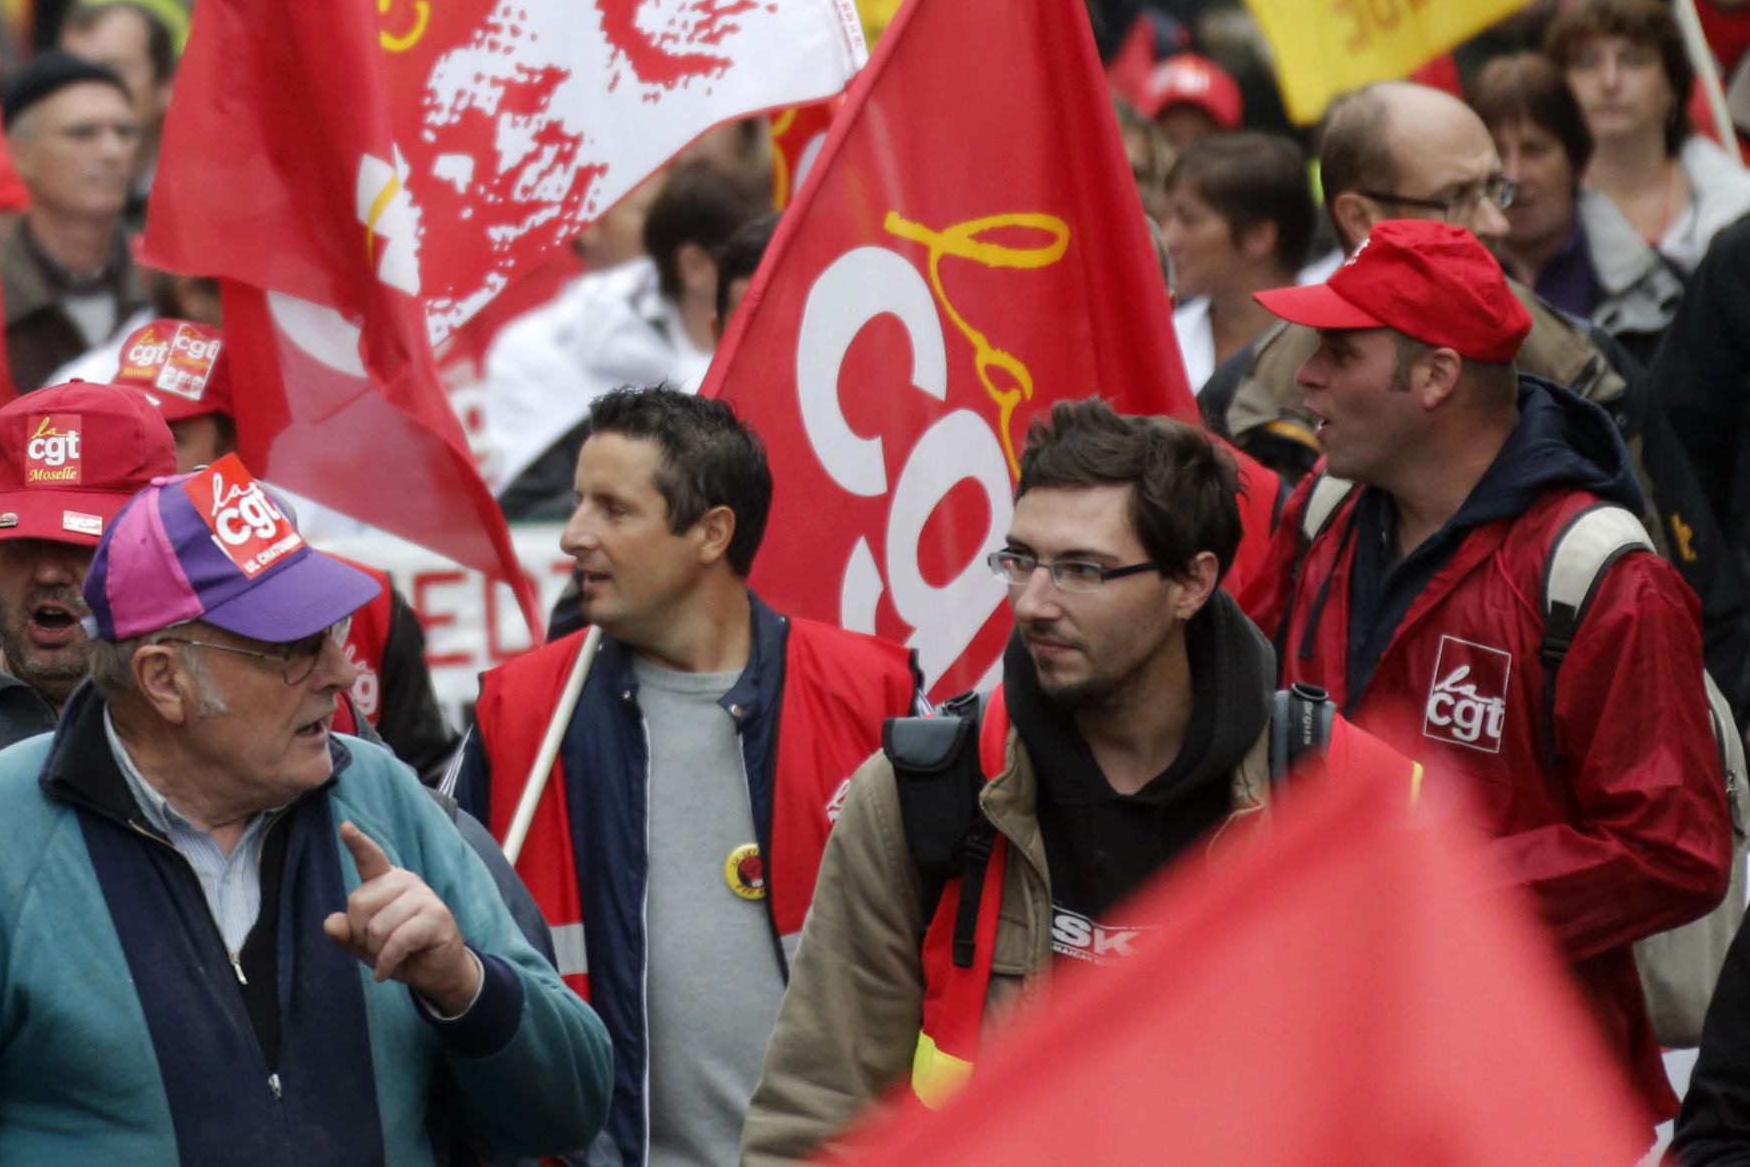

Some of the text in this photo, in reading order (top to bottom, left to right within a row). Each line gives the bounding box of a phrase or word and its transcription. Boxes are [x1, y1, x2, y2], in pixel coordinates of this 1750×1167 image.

[128, 341, 169, 367] cgt
[31, 417, 79, 439] la
[28, 431, 80, 466] cgt
[29, 466, 77, 482] Moselle
[215, 482, 281, 546] cgt
[1427, 691, 1506, 742] cgt
